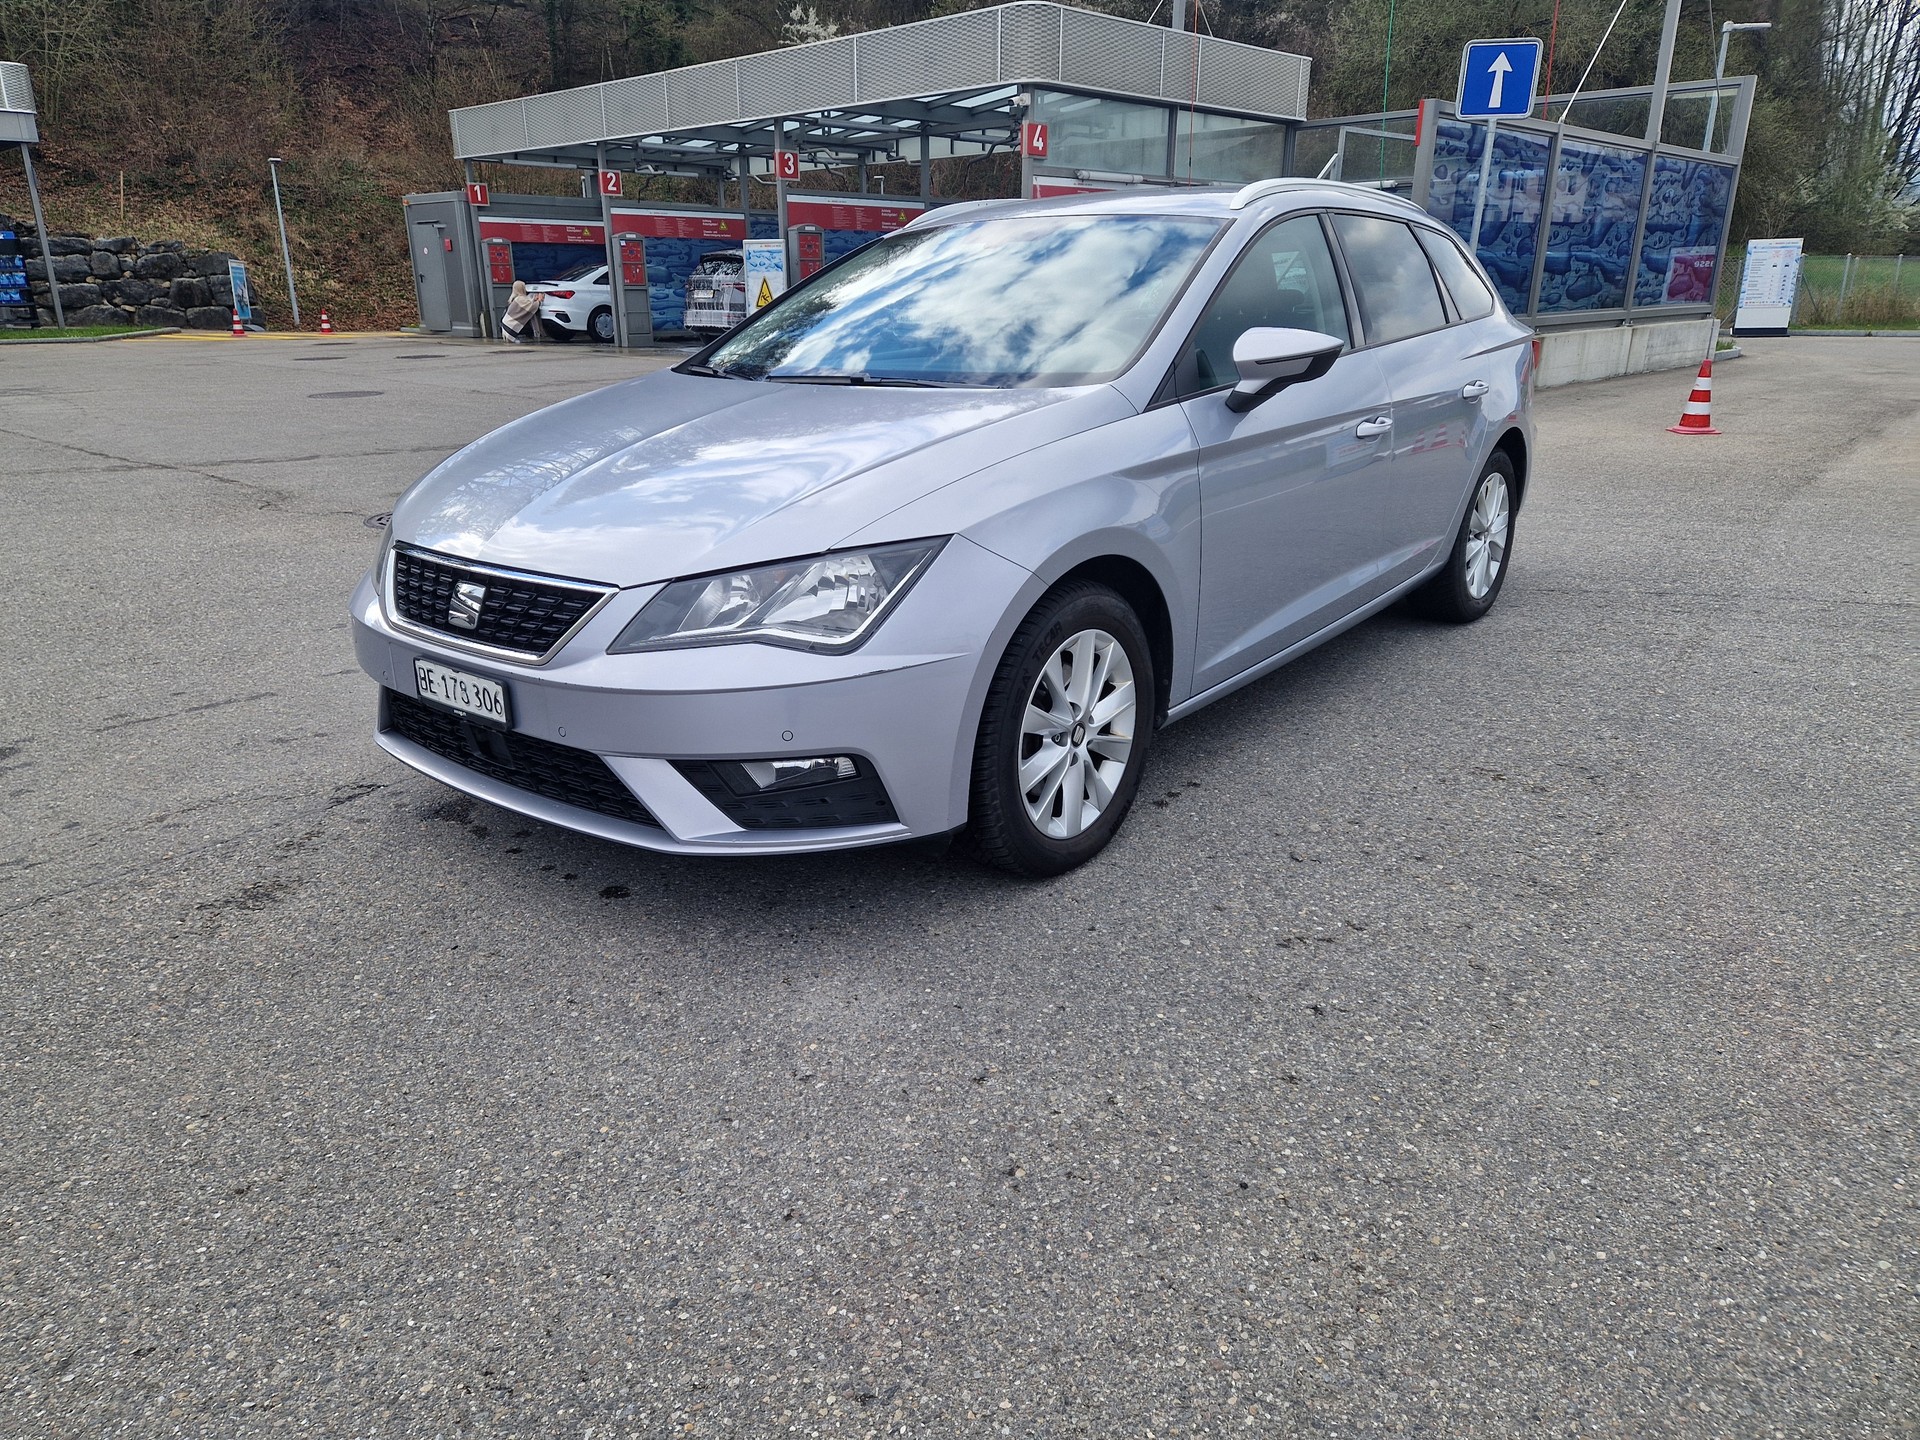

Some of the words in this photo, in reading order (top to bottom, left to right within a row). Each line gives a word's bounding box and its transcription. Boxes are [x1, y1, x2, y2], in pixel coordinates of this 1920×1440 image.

[1032, 125, 1044, 151] 4
[784, 153, 795, 175] 3
[606, 172, 617, 191] 2
[474, 185, 482, 202] 1
[418, 667, 437, 694] BE
[472, 683, 503, 715] 306
